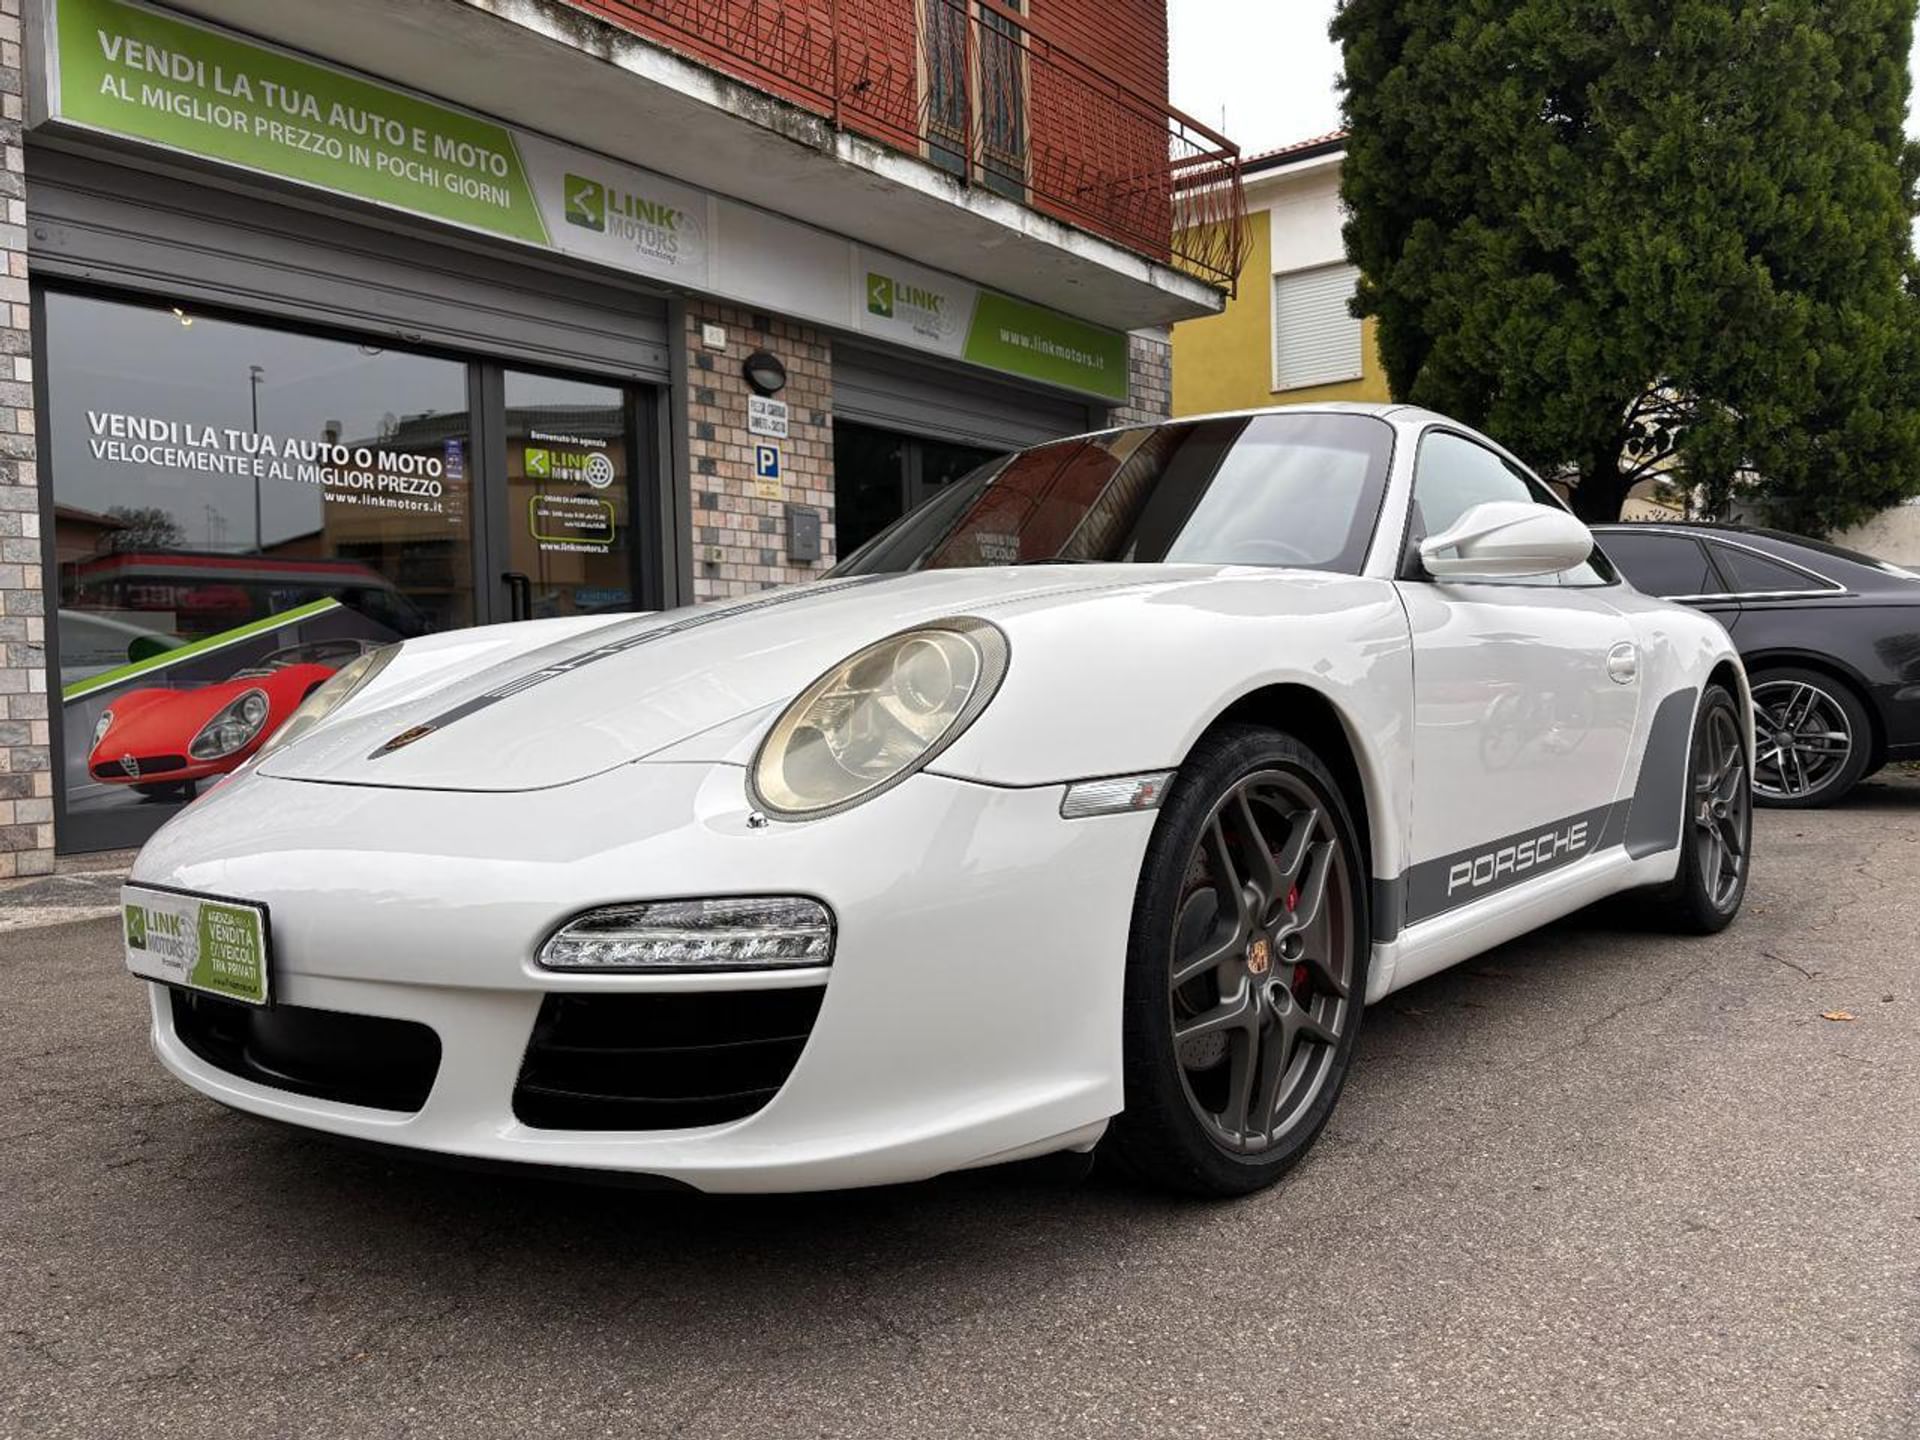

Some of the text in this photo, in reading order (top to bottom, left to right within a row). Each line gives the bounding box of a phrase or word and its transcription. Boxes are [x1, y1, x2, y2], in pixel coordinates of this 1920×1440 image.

[98, 29, 508, 177] VENDI LA TUA AUTO E MOTO
[100, 74, 510, 209] AL MIGLIOR PREZZO IN POCHI GIORNI
[608, 215, 679, 253] MOTORS
[1000, 328, 1104, 370] www.linkmotors.it
[88, 410, 177, 444] VENDI
[185, 424, 220, 449] LA
[224, 429, 277, 456] TUA
[283, 438, 350, 465] AUTO
[354, 448, 372, 468] O
[378, 451, 442, 477] MOTO
[531, 430, 570, 443] Benvenuto
[580, 438, 607, 448] agenzia
[90, 439, 442, 497] VELOCEMENTE E AL MIGLIOR PREZZO
[759, 448, 775, 474] P
[324, 492, 443, 513] www.linkmotors.it
[540, 542, 609, 553] www.linkmotors.it
[1447, 821, 1588, 896] PORSCHE
[147, 933, 185, 959] MOTORS
[209, 922, 254, 948] VENDITA
